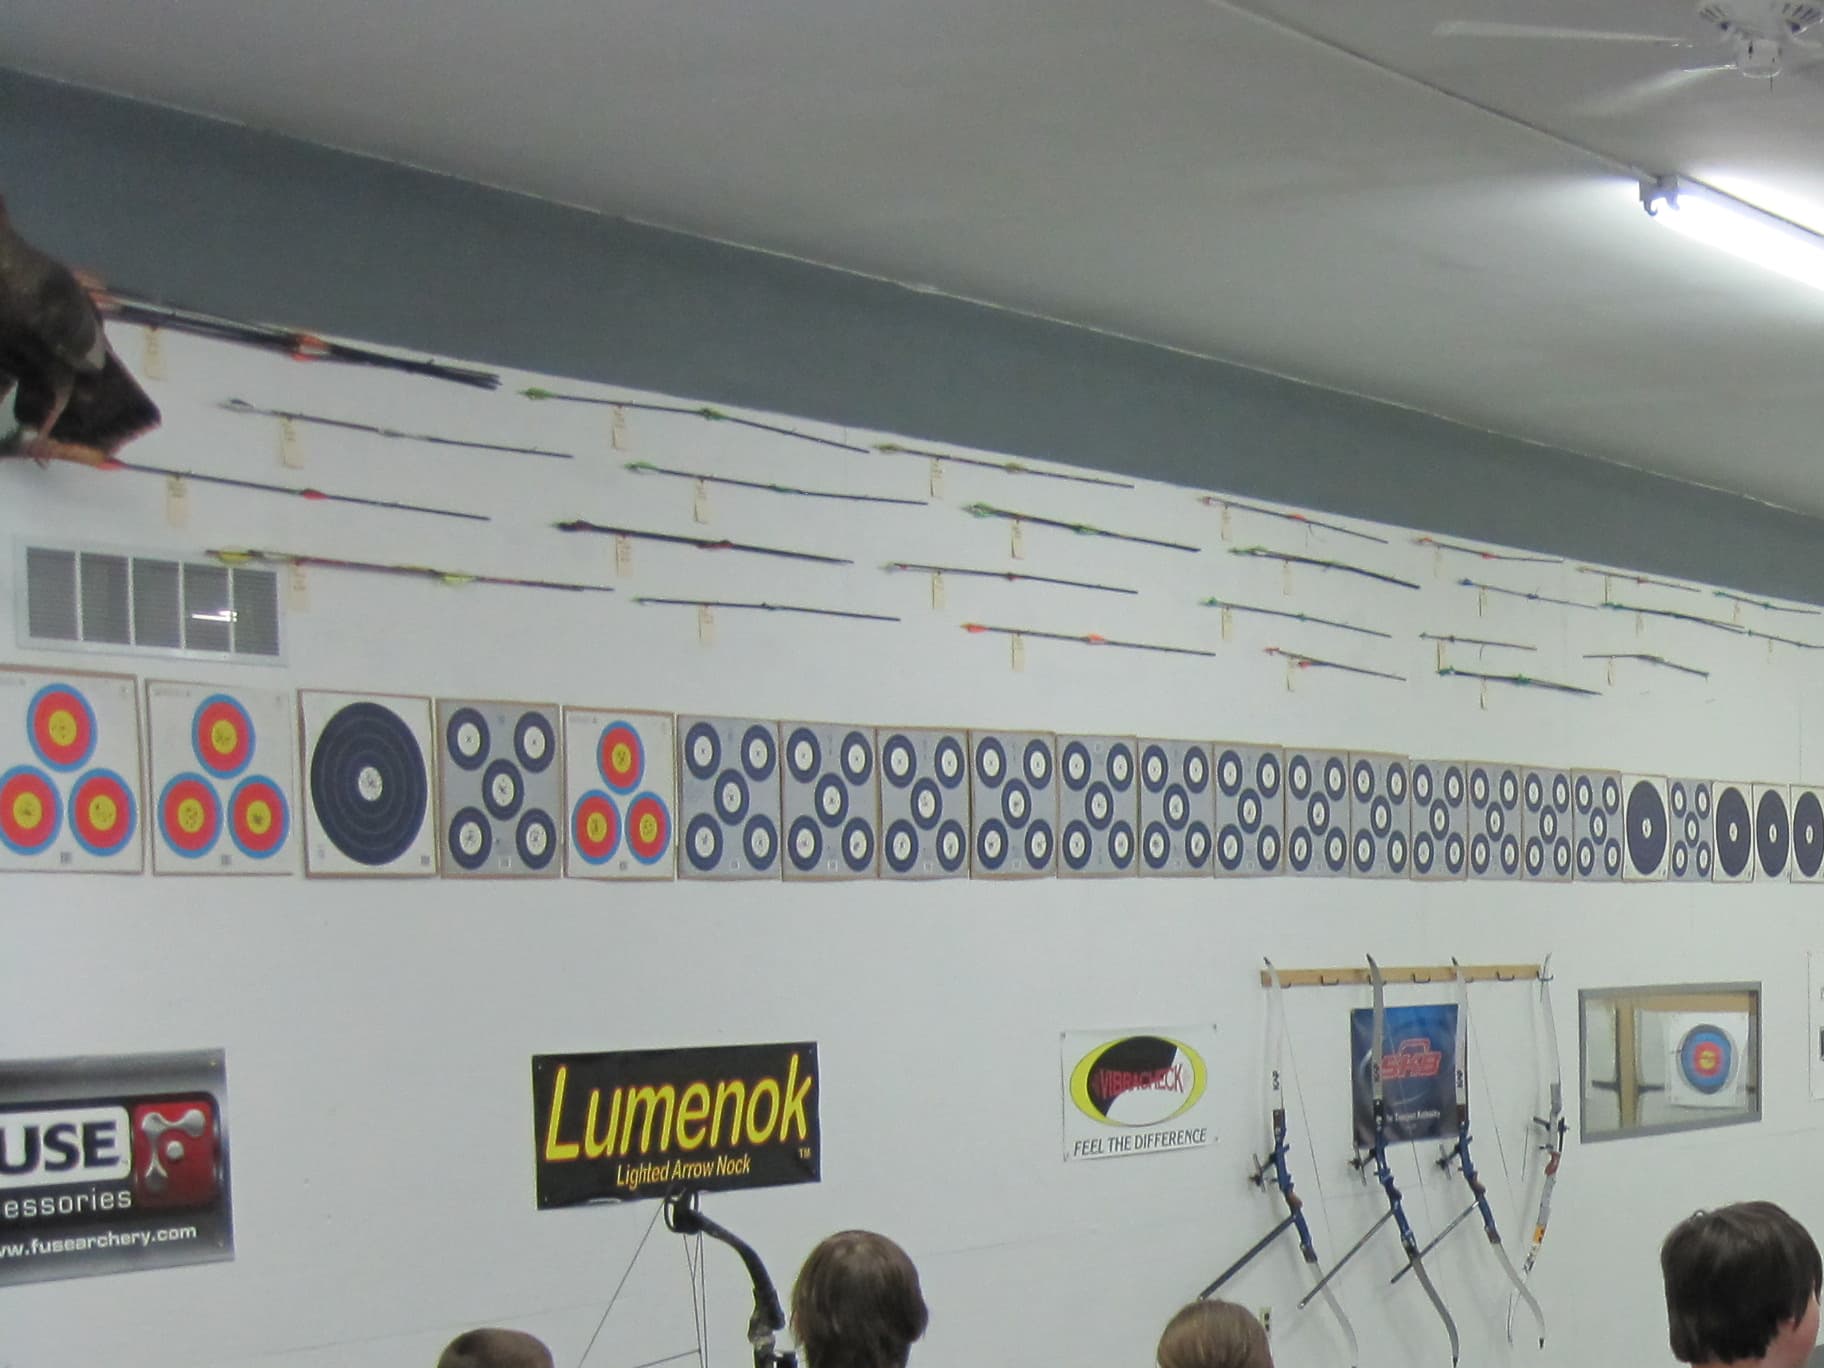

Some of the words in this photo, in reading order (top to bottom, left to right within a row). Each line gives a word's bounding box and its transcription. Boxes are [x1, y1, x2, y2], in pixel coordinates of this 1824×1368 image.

[546, 1053, 812, 1161] Lumenok
[1073, 1140, 1105, 1157] FEEL
[1107, 1135, 1131, 1153] THE
[1134, 1128, 1207, 1150] DIFFERENCE
[617, 1160, 670, 1191] Lighted
[671, 1158, 715, 1182] Arrow
[716, 1153, 751, 1177] Nock
